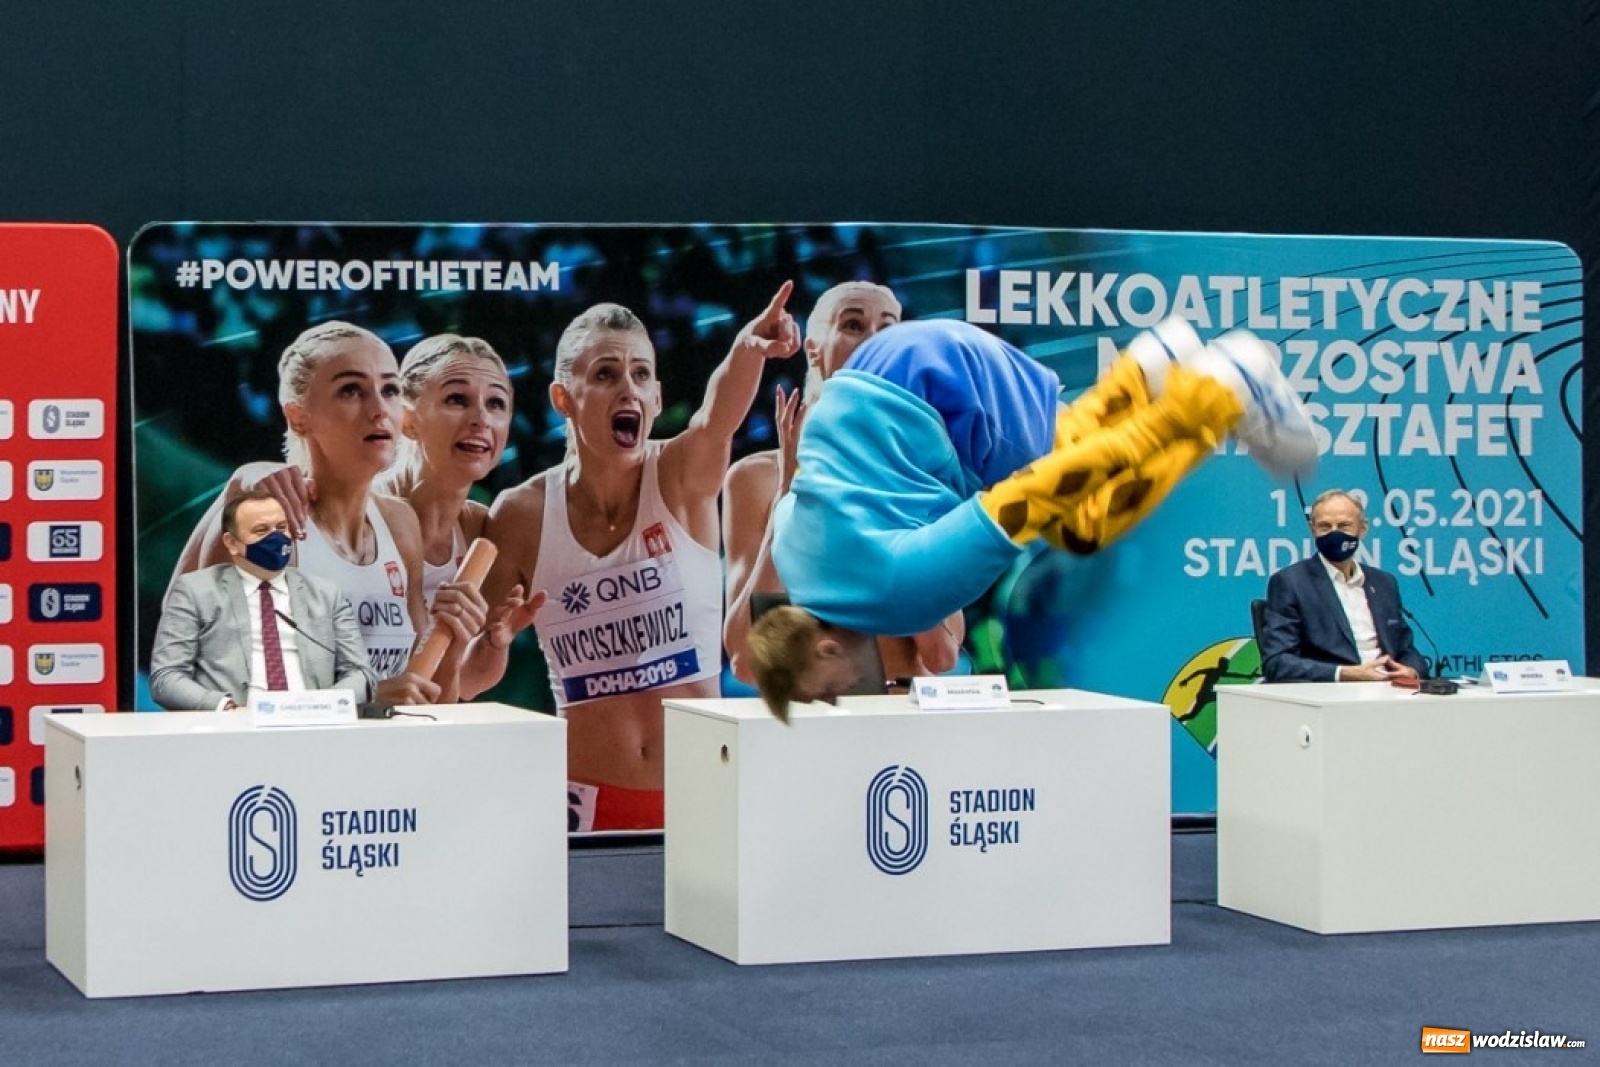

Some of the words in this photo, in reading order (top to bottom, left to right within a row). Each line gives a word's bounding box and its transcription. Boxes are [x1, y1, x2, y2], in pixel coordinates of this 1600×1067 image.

[176, 259, 560, 291] #POWEROFTHETEAM
[965, 269, 1542, 333] LEKKOATLETYCZNE
[1097, 336, 1543, 394] ZOSTWA
[1183, 537, 1382, 577] STADIN
[1397, 527, 1544, 586] ŚLĄSKI
[596, 566, 662, 602] QNB
[358, 601, 403, 627] QNB
[551, 601, 687, 668] WYCISZKIEWICZ
[585, 658, 678, 696] DOHA2019
[950, 788, 1035, 814] STADION
[322, 808, 416, 836] STADION
[950, 817, 1019, 853] ŚLĄSKI
[322, 839, 399, 877] ŚLĄSKI
